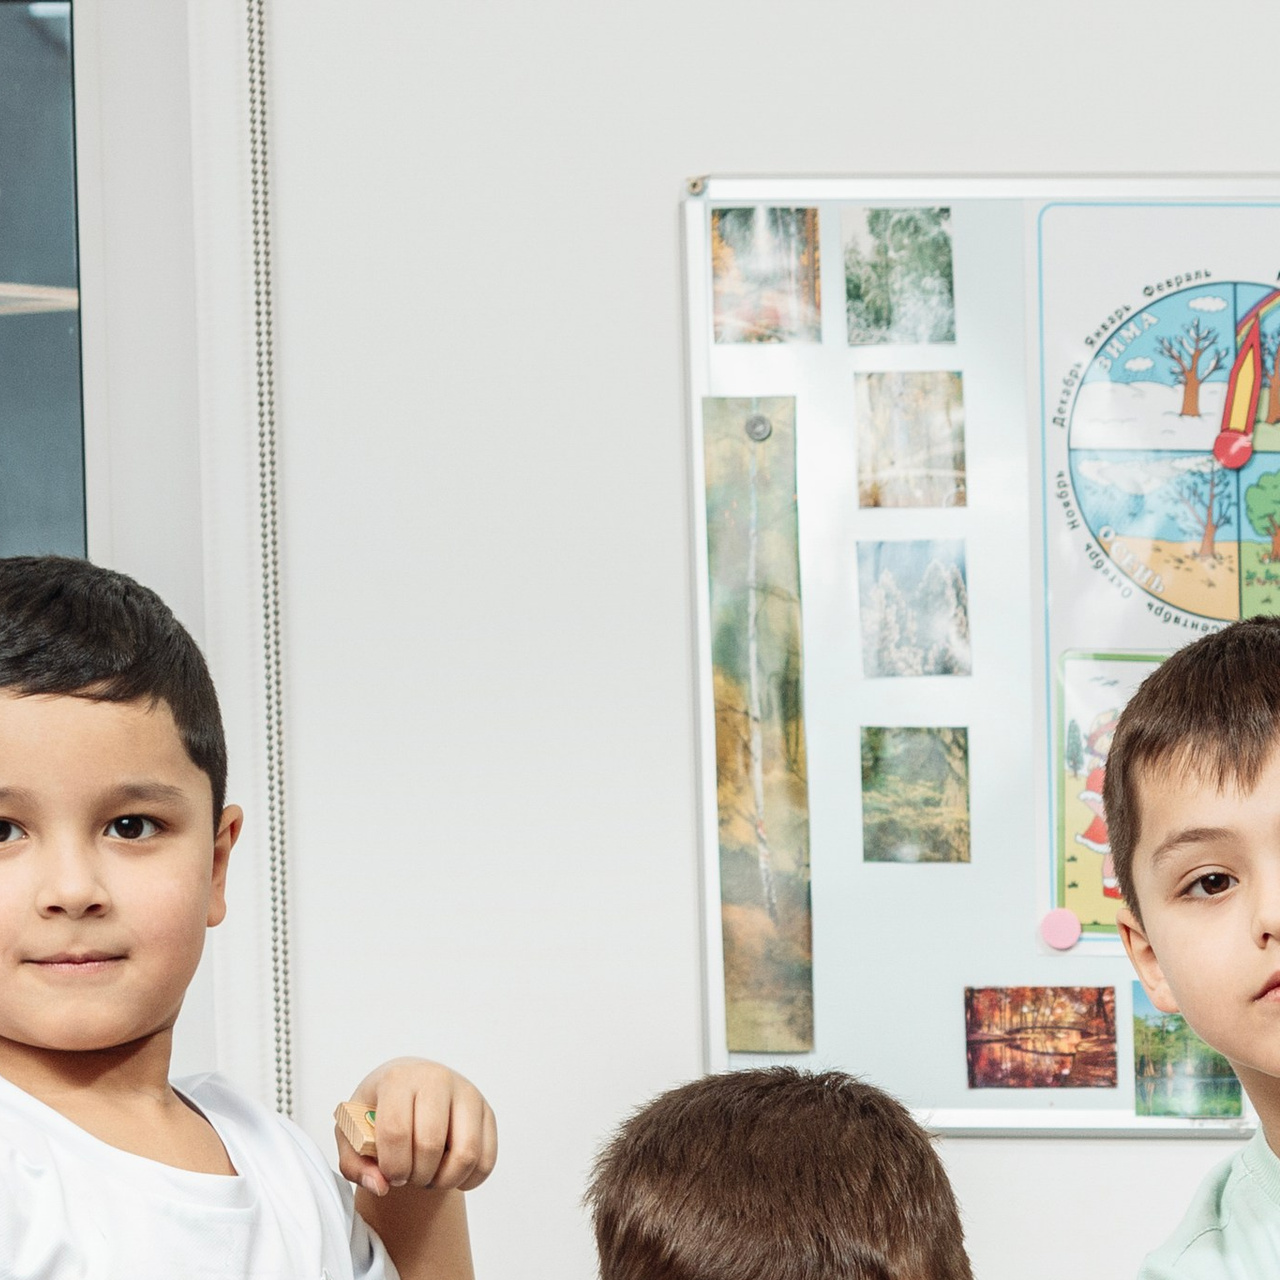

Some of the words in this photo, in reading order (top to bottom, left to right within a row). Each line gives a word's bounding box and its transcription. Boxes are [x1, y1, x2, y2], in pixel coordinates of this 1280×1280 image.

[1142, 269, 1212, 297] Февраль
[1084, 304, 1132, 348] Январь
[1099, 311, 1160, 370] ЗИМА
[1052, 362, 1083, 428] Декабрь
[1056, 471, 1081, 530] Ноябрь
[1084, 543, 1133, 599] Октябрь
[1099, 525, 1165, 594] ОСЕНЬ
